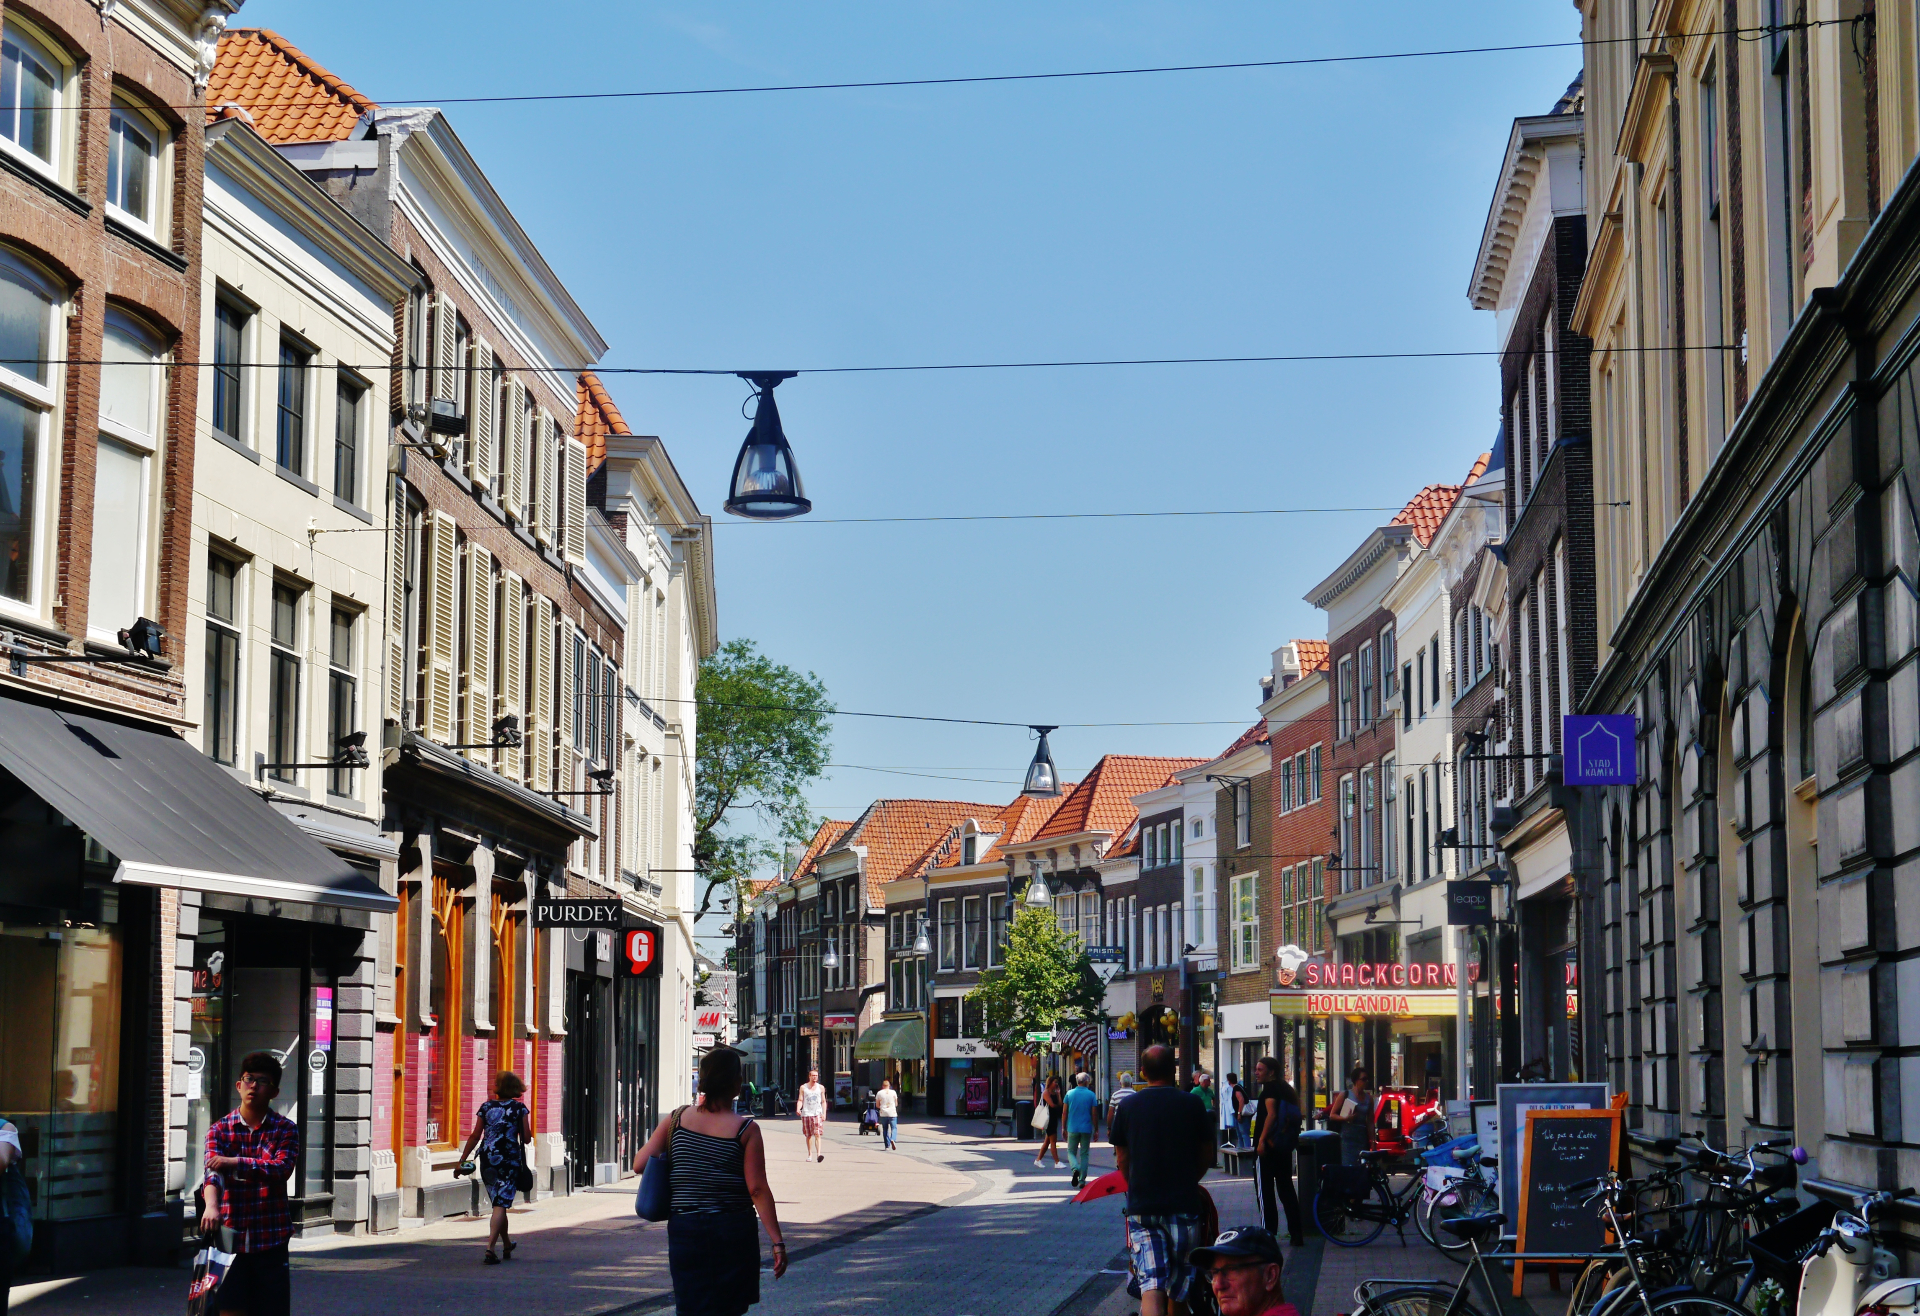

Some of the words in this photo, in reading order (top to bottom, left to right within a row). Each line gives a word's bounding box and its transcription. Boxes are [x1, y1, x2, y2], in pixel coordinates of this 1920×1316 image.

[1588, 759, 1611, 768] STAD
[1585, 768, 1614, 777] KAMER
[1453, 893, 1486, 905] leapp
[1307, 994, 1410, 1013] HOLLANDIA
[697, 1012, 720, 1027] H&M
